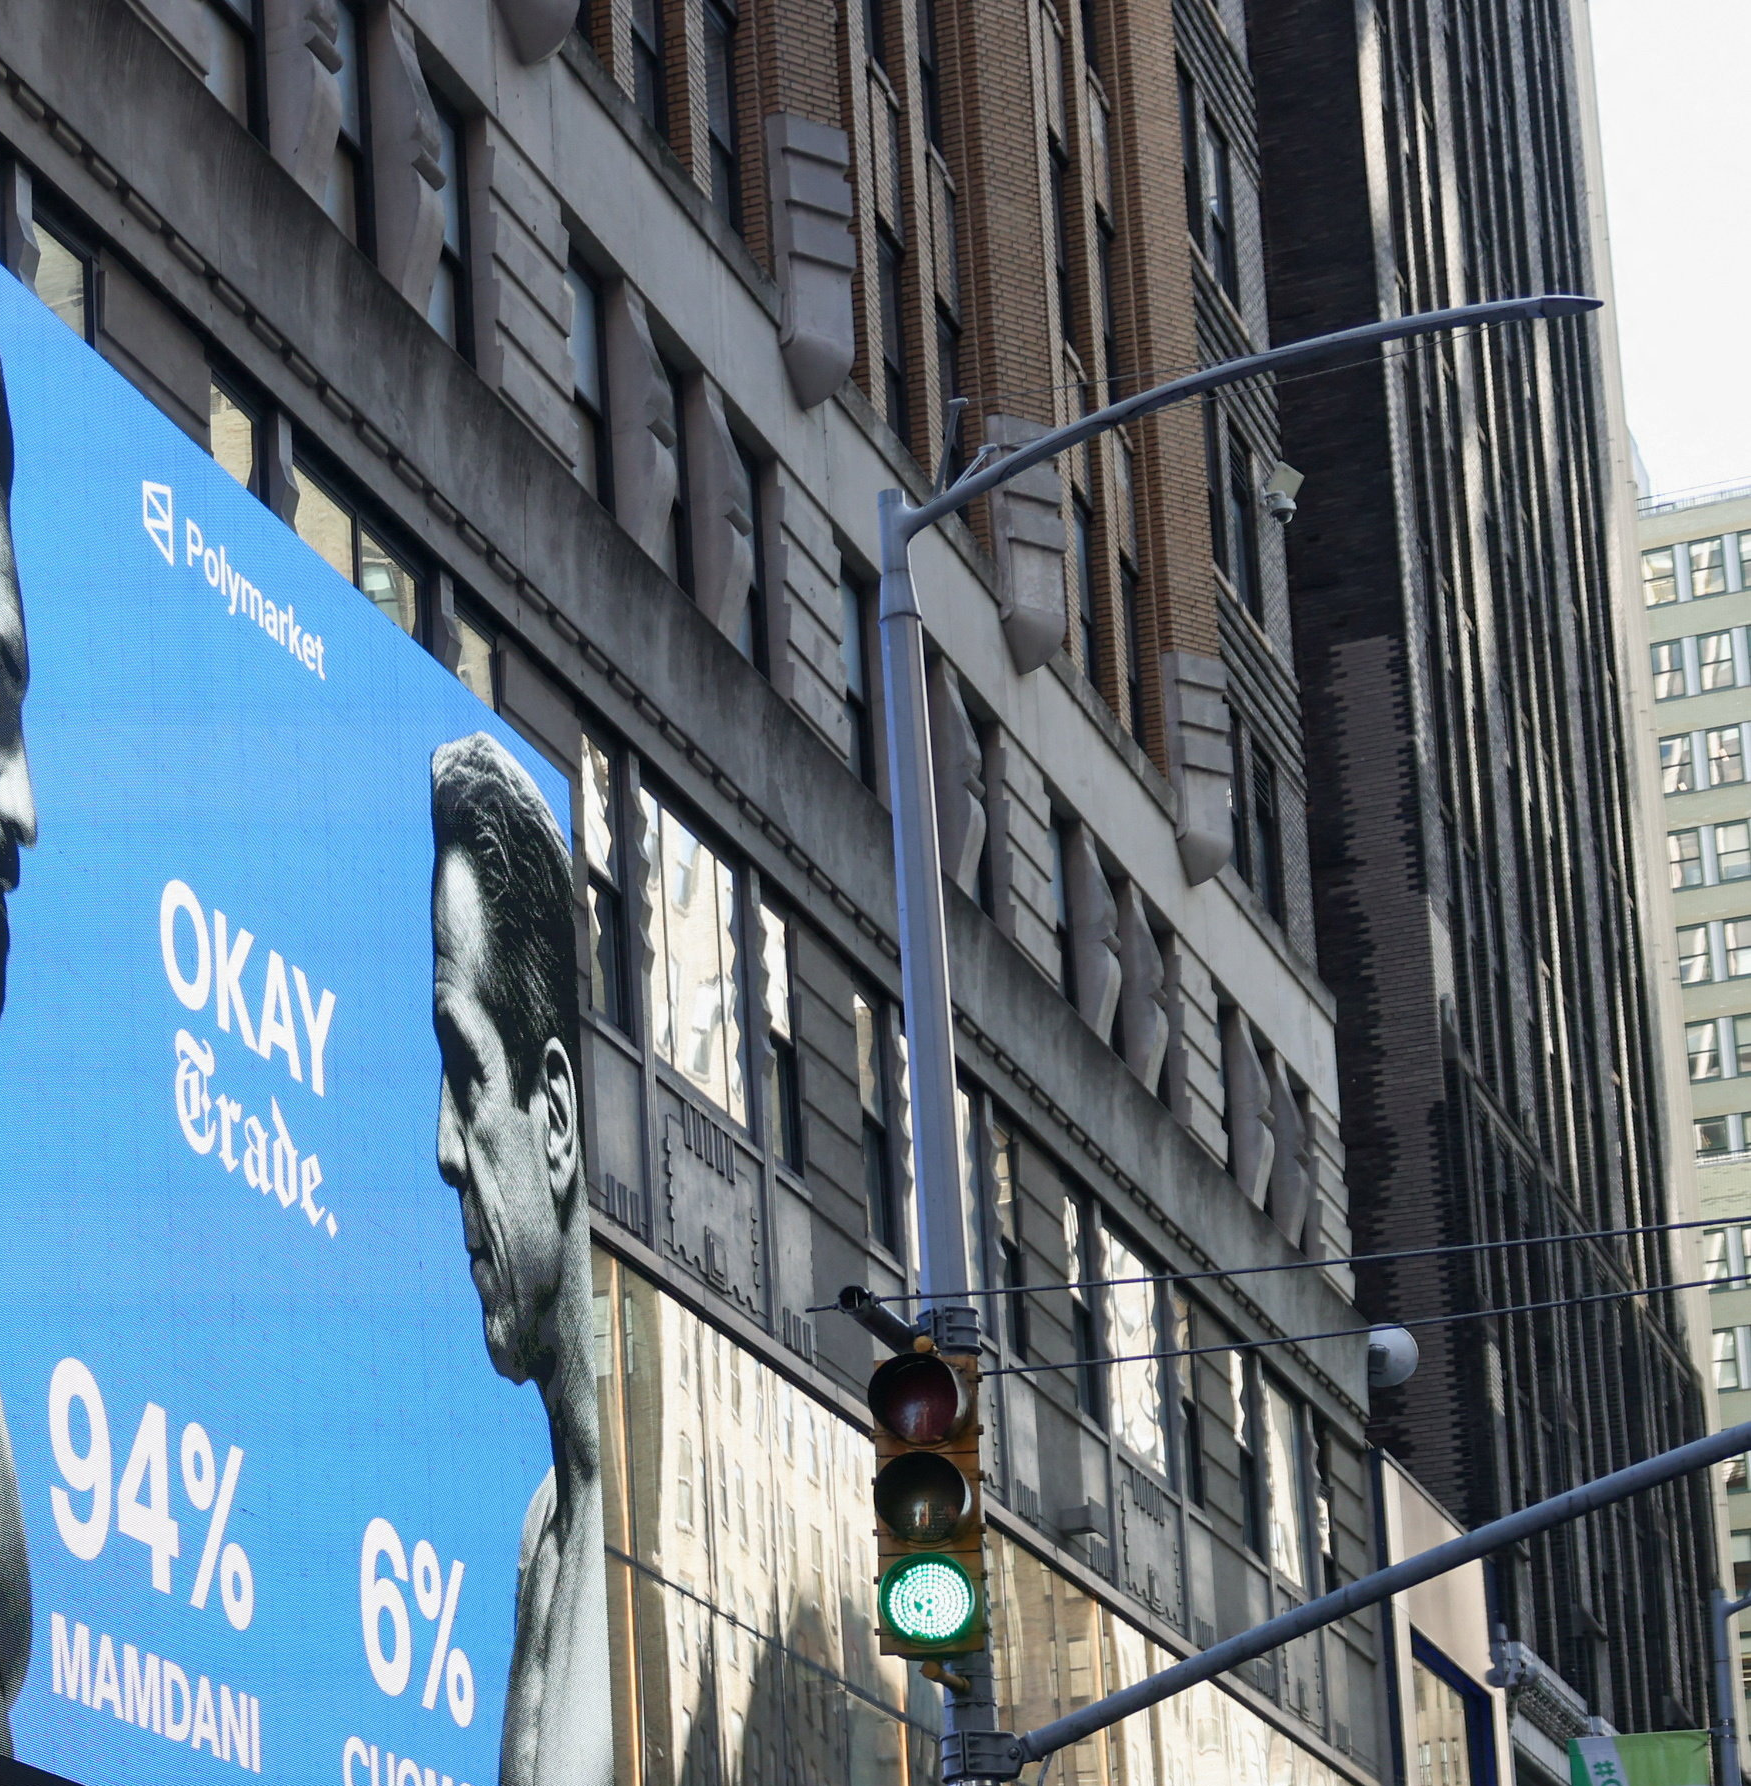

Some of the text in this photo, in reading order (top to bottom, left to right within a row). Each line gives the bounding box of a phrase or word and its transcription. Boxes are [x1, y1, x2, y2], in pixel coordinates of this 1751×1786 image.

[186, 518, 326, 681] Polymarket
[159, 878, 337, 1099] OKAY
[174, 1028, 339, 1239] Trade.
[48, 1356, 475, 1728] 94% 6%
[51, 1610, 261, 1774] MAMDANI
